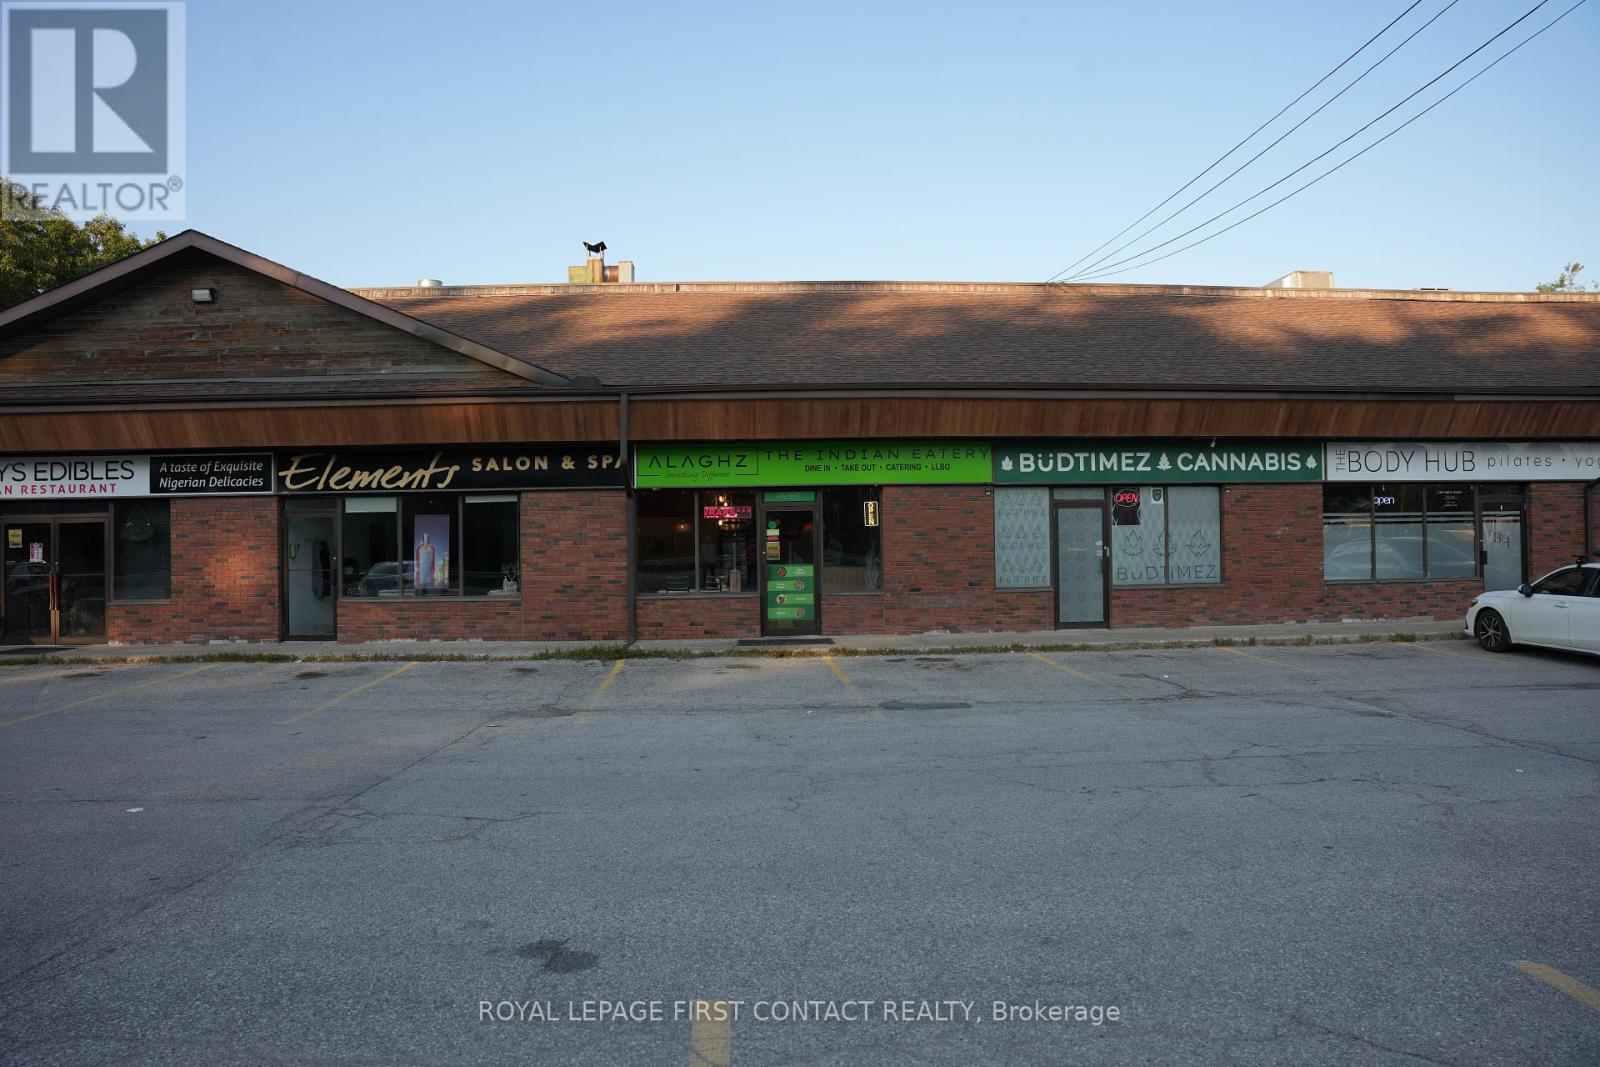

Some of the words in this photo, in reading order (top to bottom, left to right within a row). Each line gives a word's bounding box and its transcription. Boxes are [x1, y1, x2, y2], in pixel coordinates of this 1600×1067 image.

[649, 454, 748, 469] ALAGHZ
[766, 450, 803, 461] THE
[816, 449, 900, 461] INDIAN
[912, 448, 989, 460] EATERY
[1177, 451, 1301, 472] CANNABIS
[1336, 449, 1346, 473] THE
[1347, 450, 1415, 473] BODY
[1425, 450, 1476, 472] HUB
[1487, 454, 1553, 470] pilates
[34, 460, 134, 481] EDIBLES
[160, 462, 167, 473] A
[170, 463, 198, 473] taste
[200, 461, 212, 475] of
[214, 460, 264, 474] Exquisite
[278, 451, 461, 490] Elements
[472, 456, 549, 472] SALON
[561, 455, 576, 470] &
[804, 464, 822, 472] DINE
[823, 464, 831, 472] IN
[841, 464, 859, 472] TAKE
[861, 464, 876, 472] OUT
[886, 463, 922, 471] CATERING
[21, 483, 117, 495] RESTAURANT
[160, 476, 206, 490] Nigerian
[208, 475, 264, 488] Delicacies
[1115, 493, 1138, 503] OPEN
[1374, 496, 1395, 506] open
